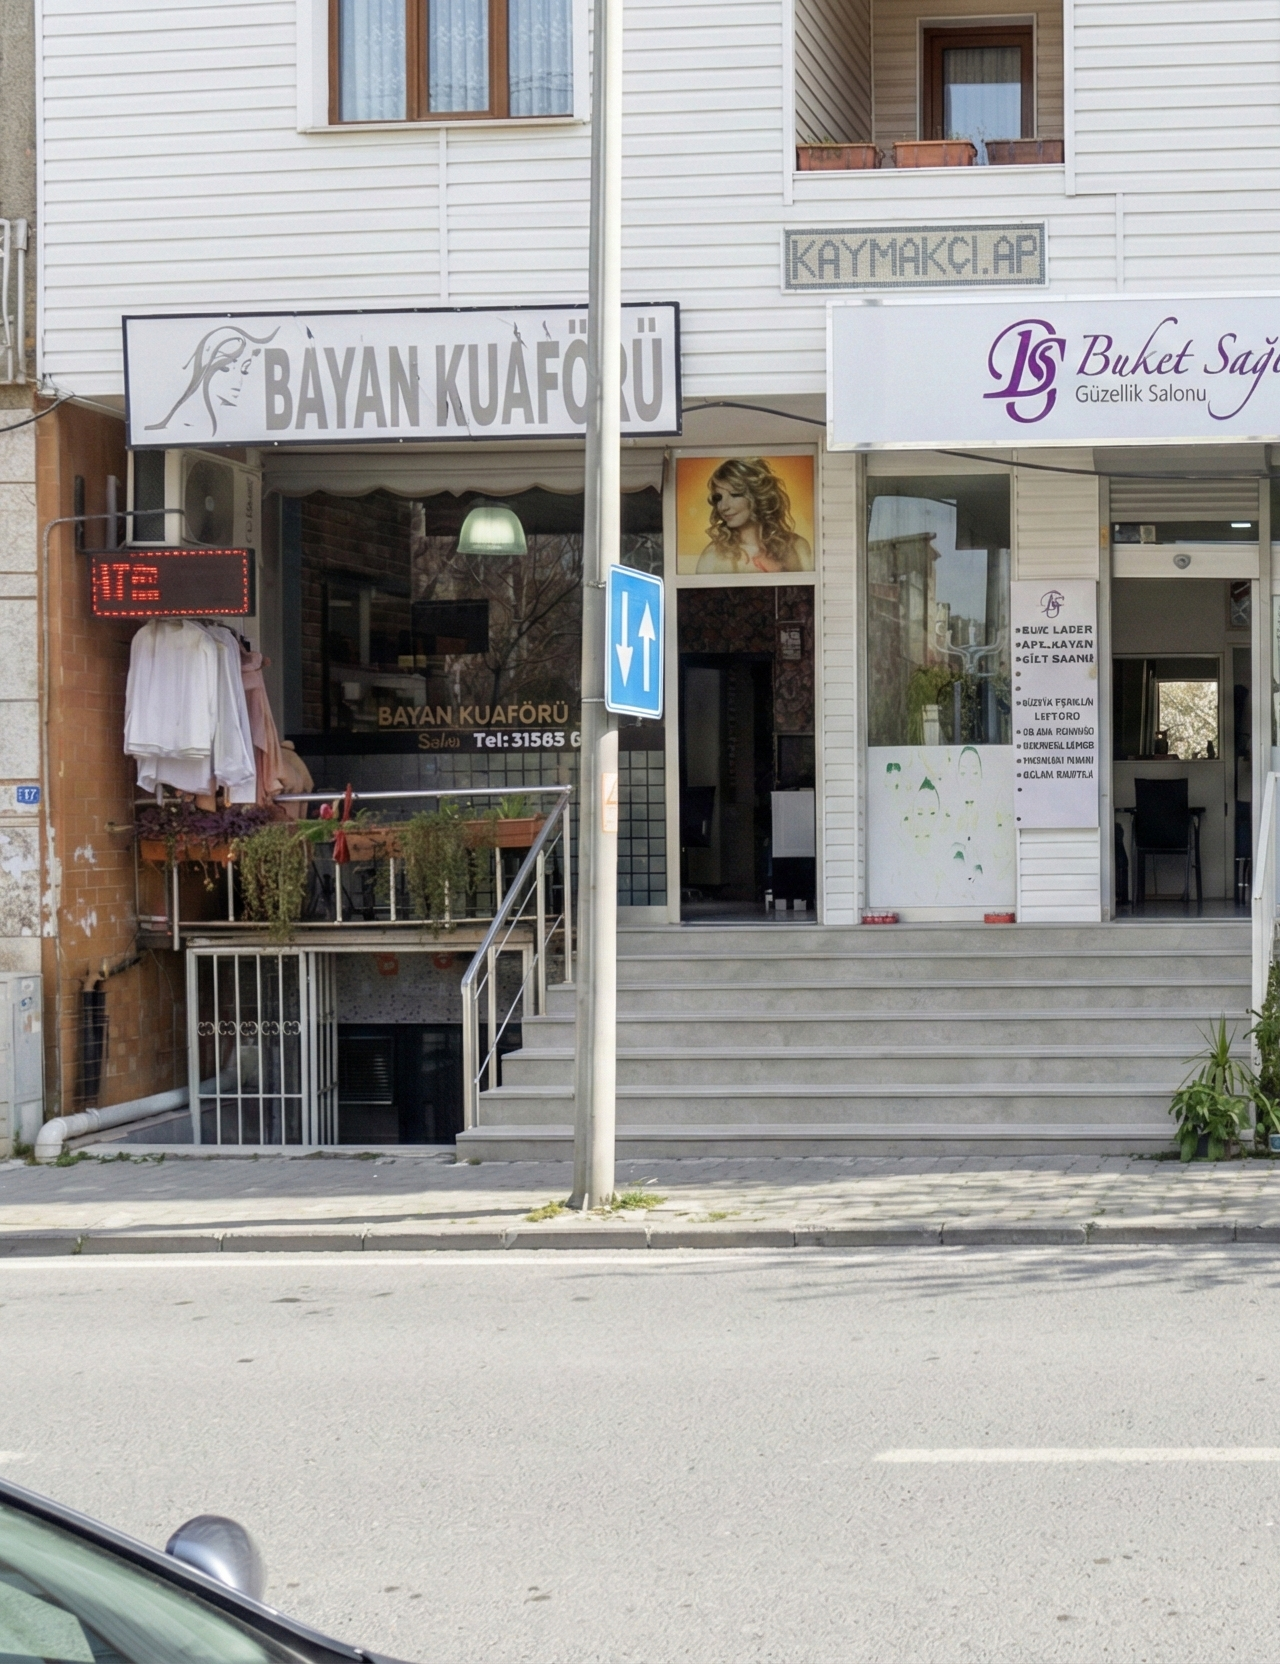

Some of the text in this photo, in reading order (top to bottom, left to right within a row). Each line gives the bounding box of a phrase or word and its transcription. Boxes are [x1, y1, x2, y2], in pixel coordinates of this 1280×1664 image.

[1075, 316, 1195, 377] Buket
[264, 344, 421, 431] BAYAN
[1075, 384, 1207, 403] Güzellik Salonu
[378, 701, 569, 726] BAYAN KUAFÖRÜ
[473, 732, 509, 748] Tel:
